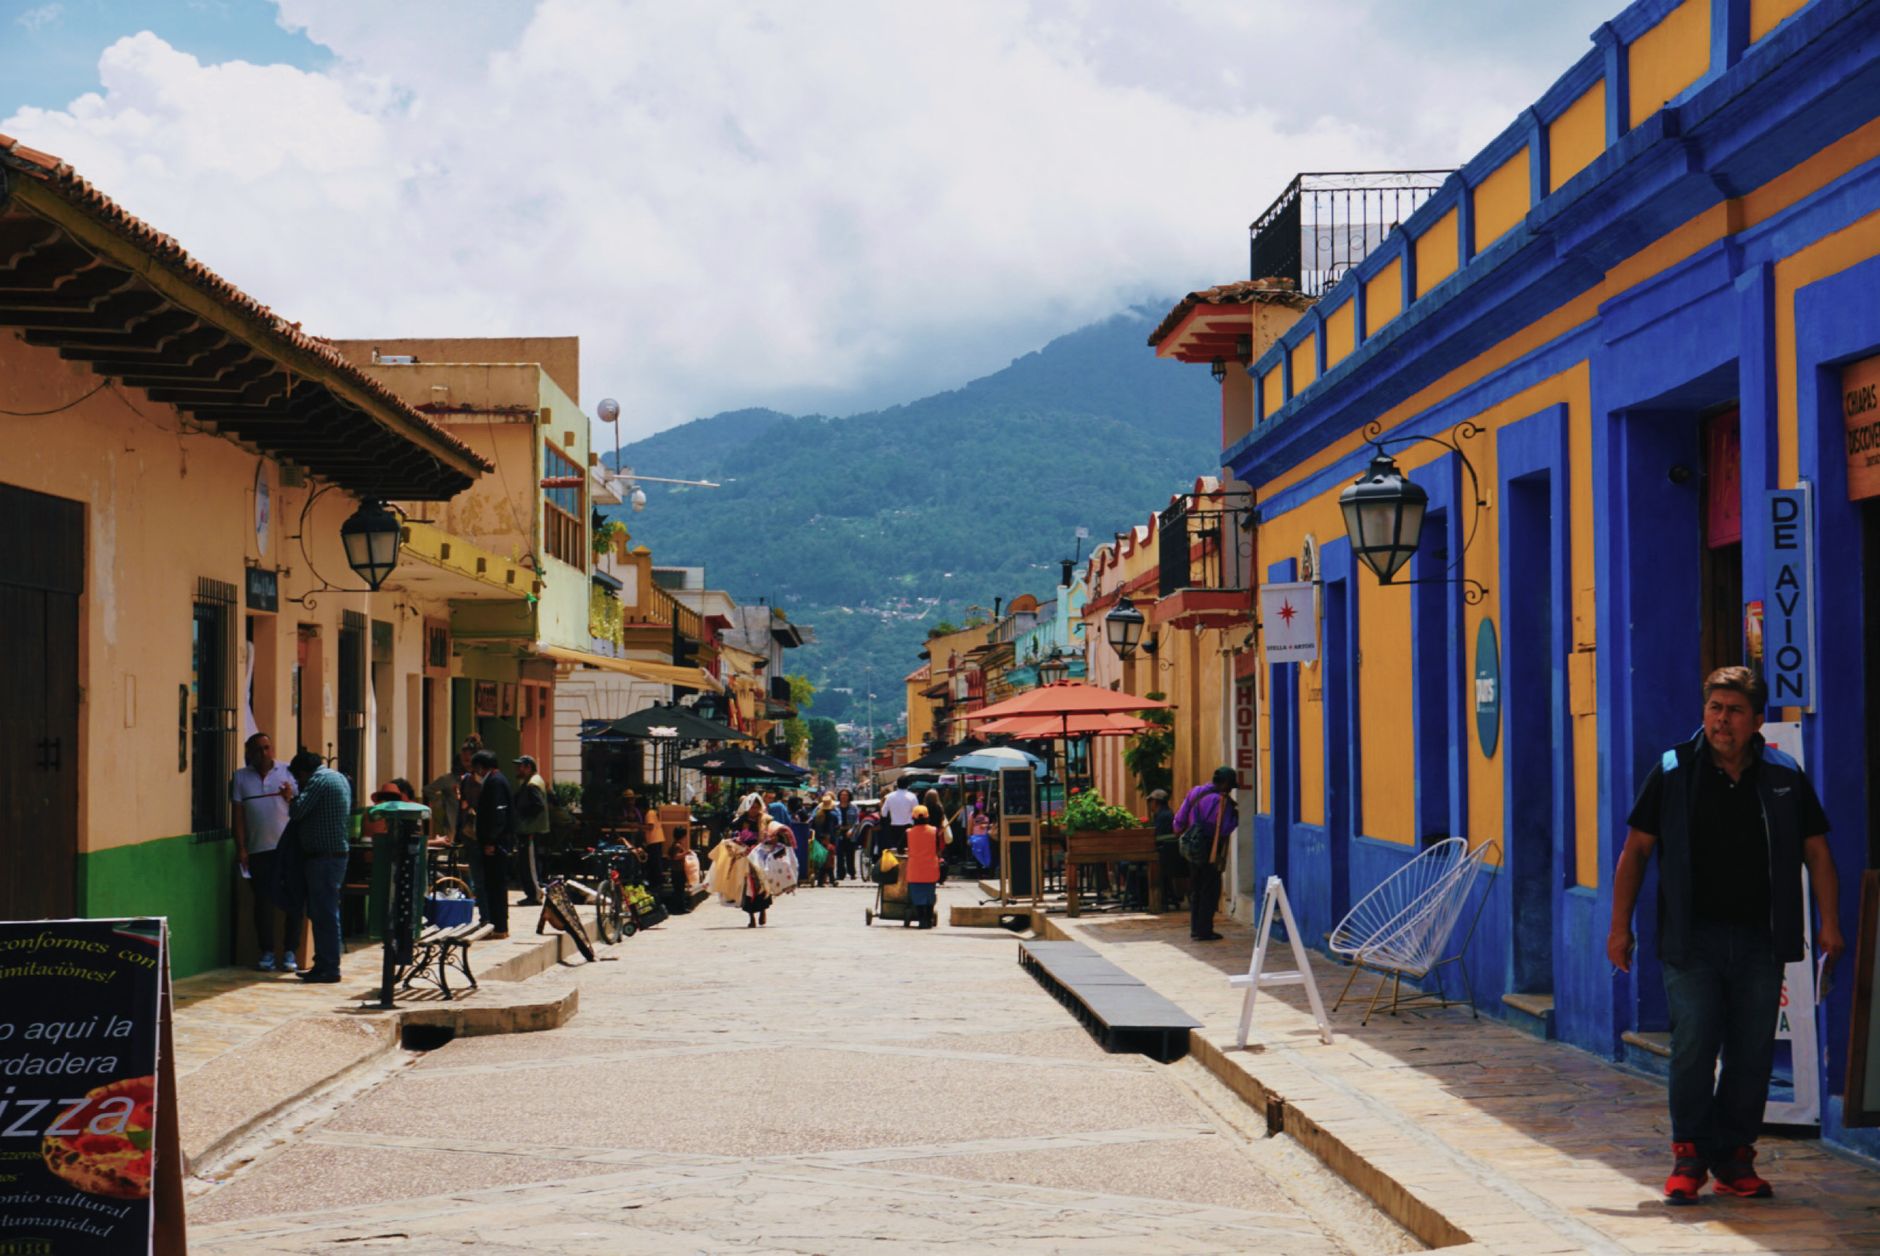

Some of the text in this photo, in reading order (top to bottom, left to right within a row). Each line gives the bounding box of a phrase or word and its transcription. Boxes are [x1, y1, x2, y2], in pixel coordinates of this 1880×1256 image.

[1771, 497, 1803, 699] DE AVION
[1236, 686, 1253, 790] HOTEL
[118, 950, 157, 969] con
[24, 1016, 99, 1044] aqui
[104, 1015, 134, 1038] la
[45, 1193, 132, 1219] cultural
